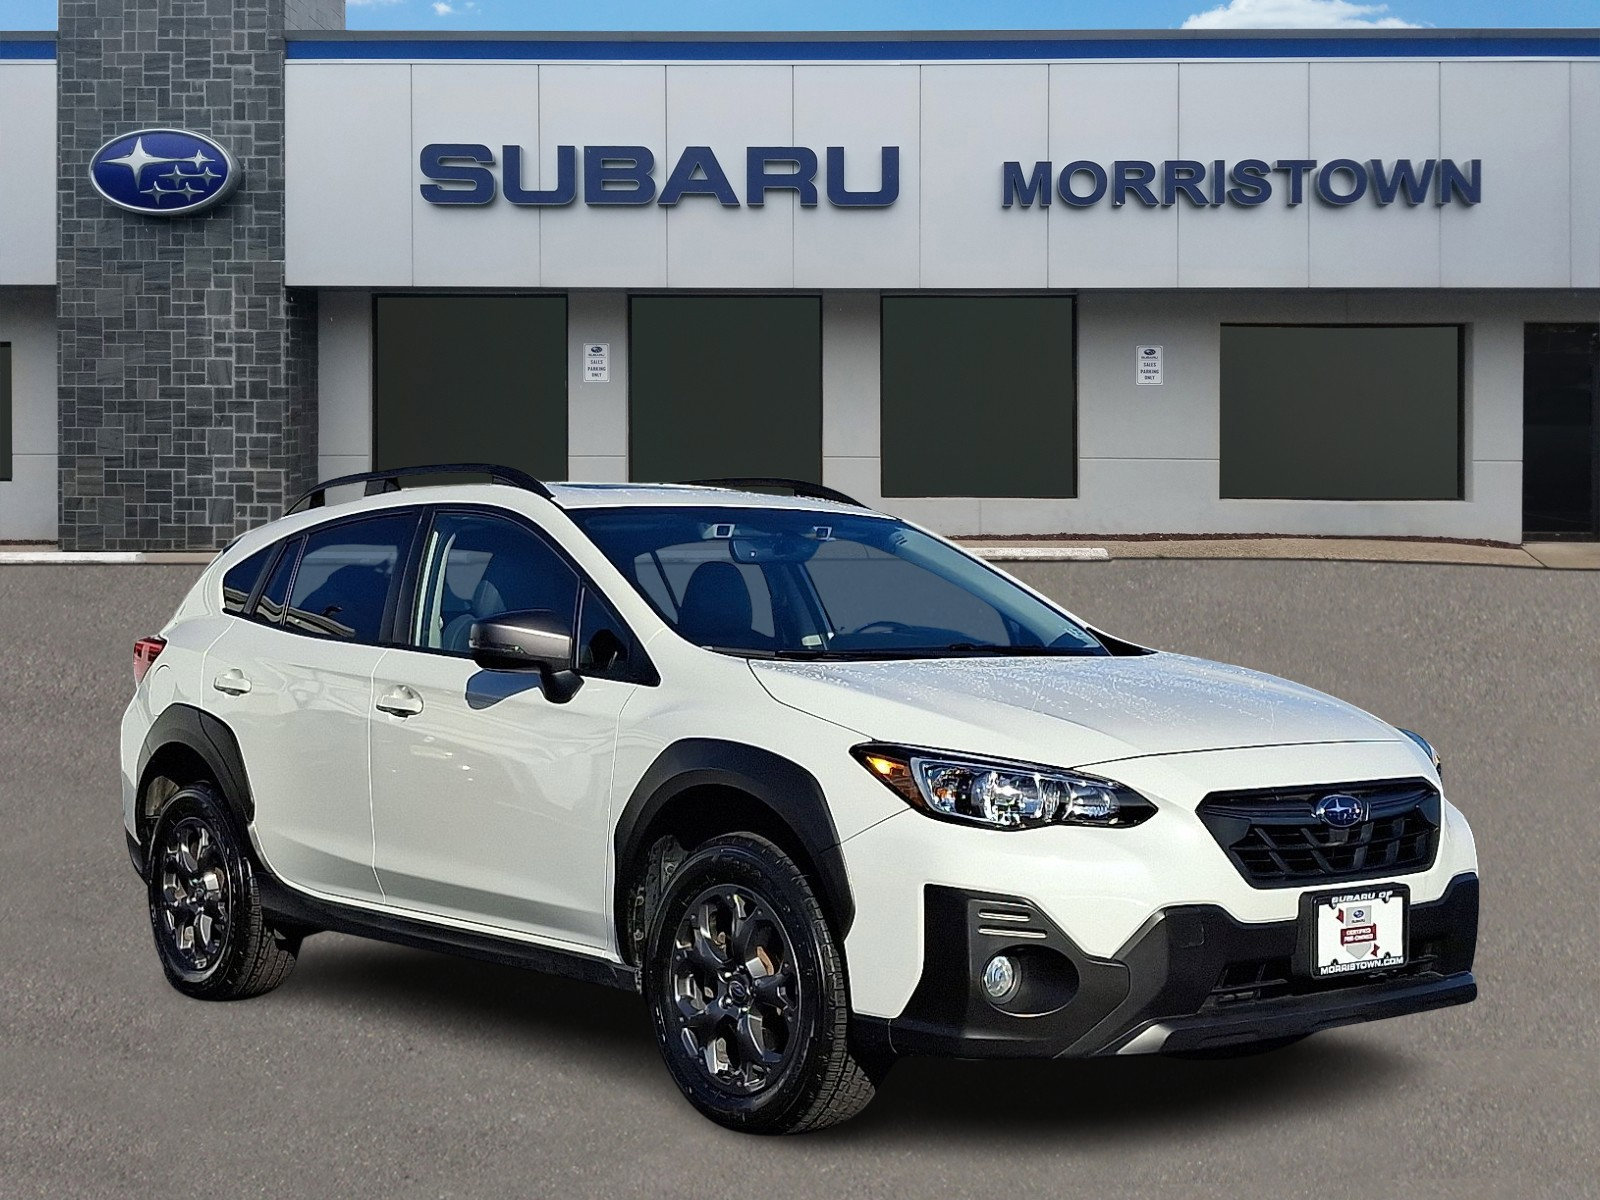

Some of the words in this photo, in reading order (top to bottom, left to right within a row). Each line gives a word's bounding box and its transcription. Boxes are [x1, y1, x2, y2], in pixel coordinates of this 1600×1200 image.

[419, 143, 899, 207] SUBARU
[1001, 158, 1482, 208] MORRISTOWN
[1331, 892, 1375, 904] SUBARU
[1320, 956, 1404, 975] MORRISTOWN.COM
